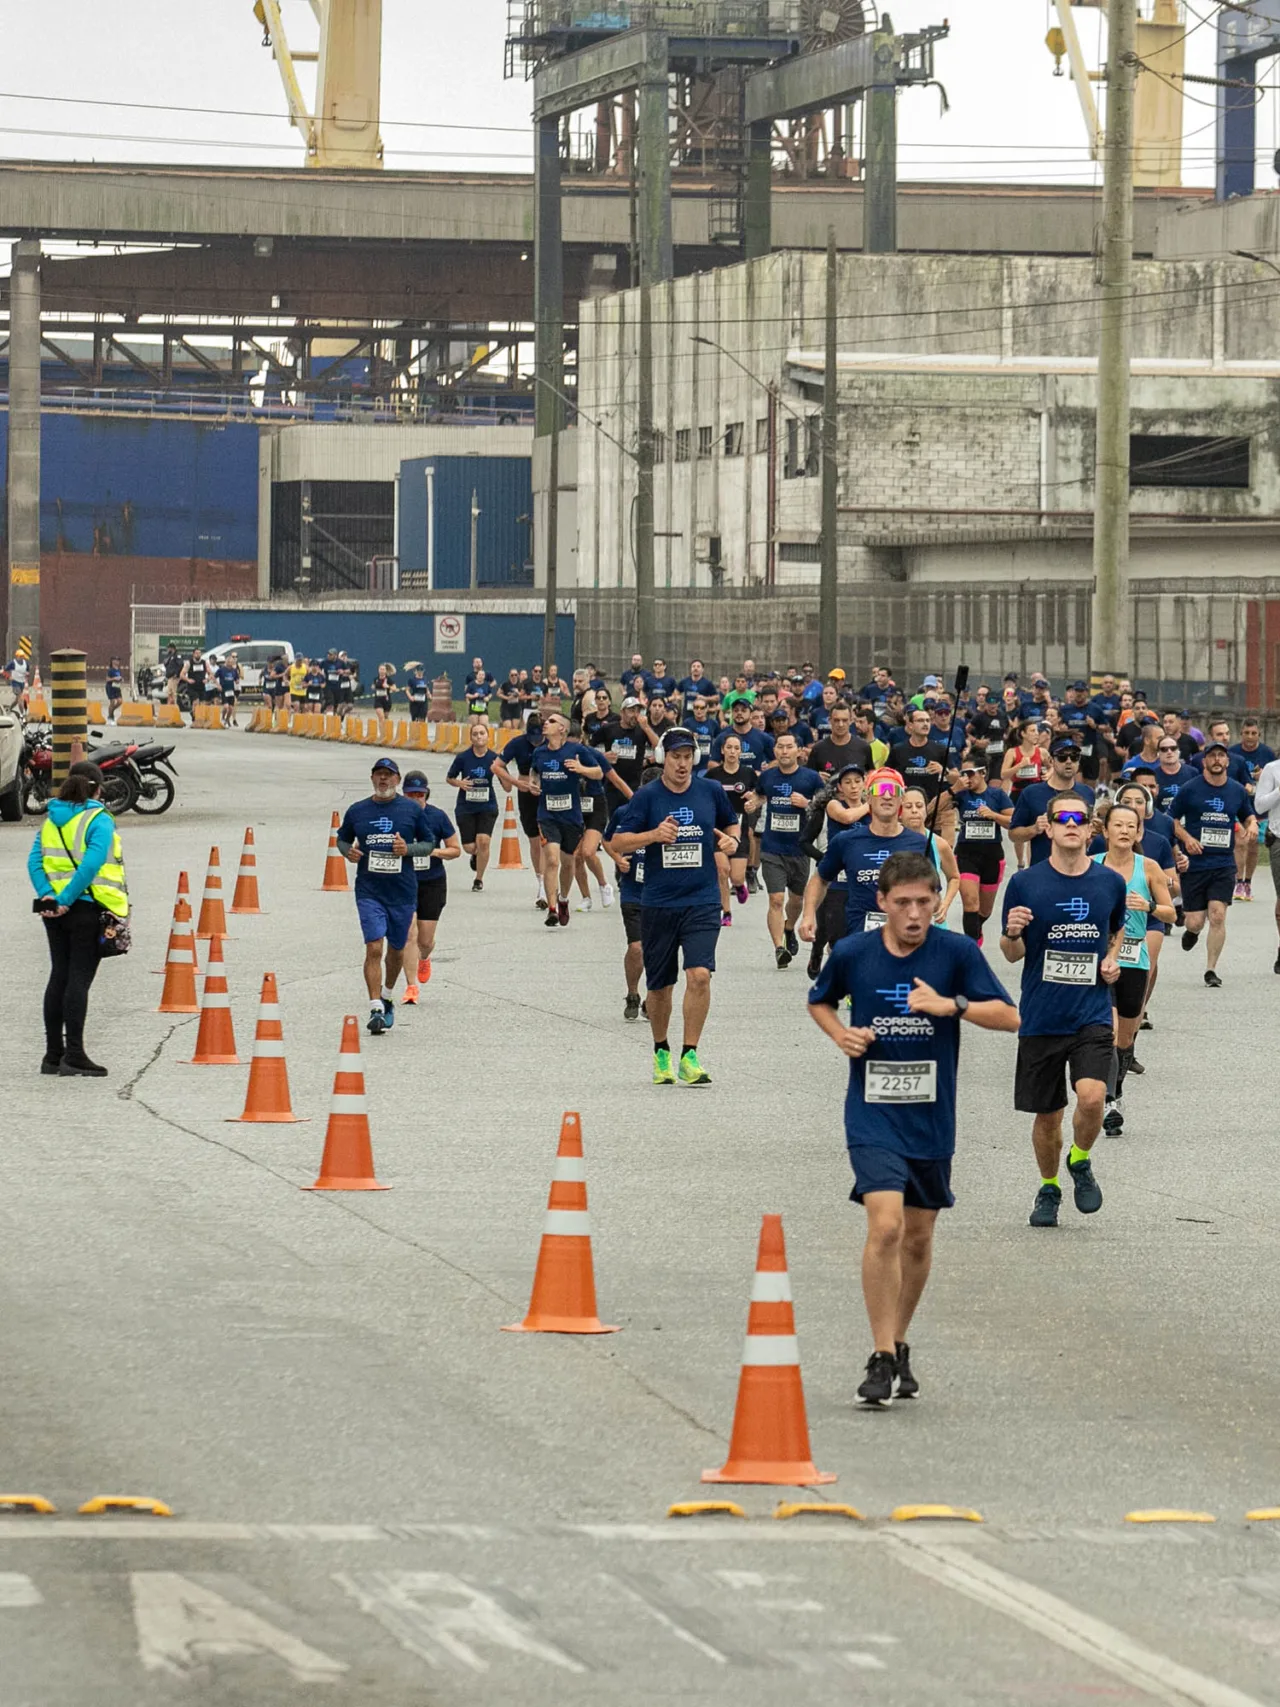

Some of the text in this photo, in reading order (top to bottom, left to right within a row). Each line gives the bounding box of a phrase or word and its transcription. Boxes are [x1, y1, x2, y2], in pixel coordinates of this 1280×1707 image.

[671, 851, 695, 861] 2447
[375, 859, 397, 867] 2292
[1051, 923, 1098, 932] CORRIDA
[1047, 931, 1100, 940] DO PORTO
[1055, 962, 1087, 976] 2172
[872, 1016, 932, 1026] CORRIDA
[881, 1076, 922, 1091] 2257
